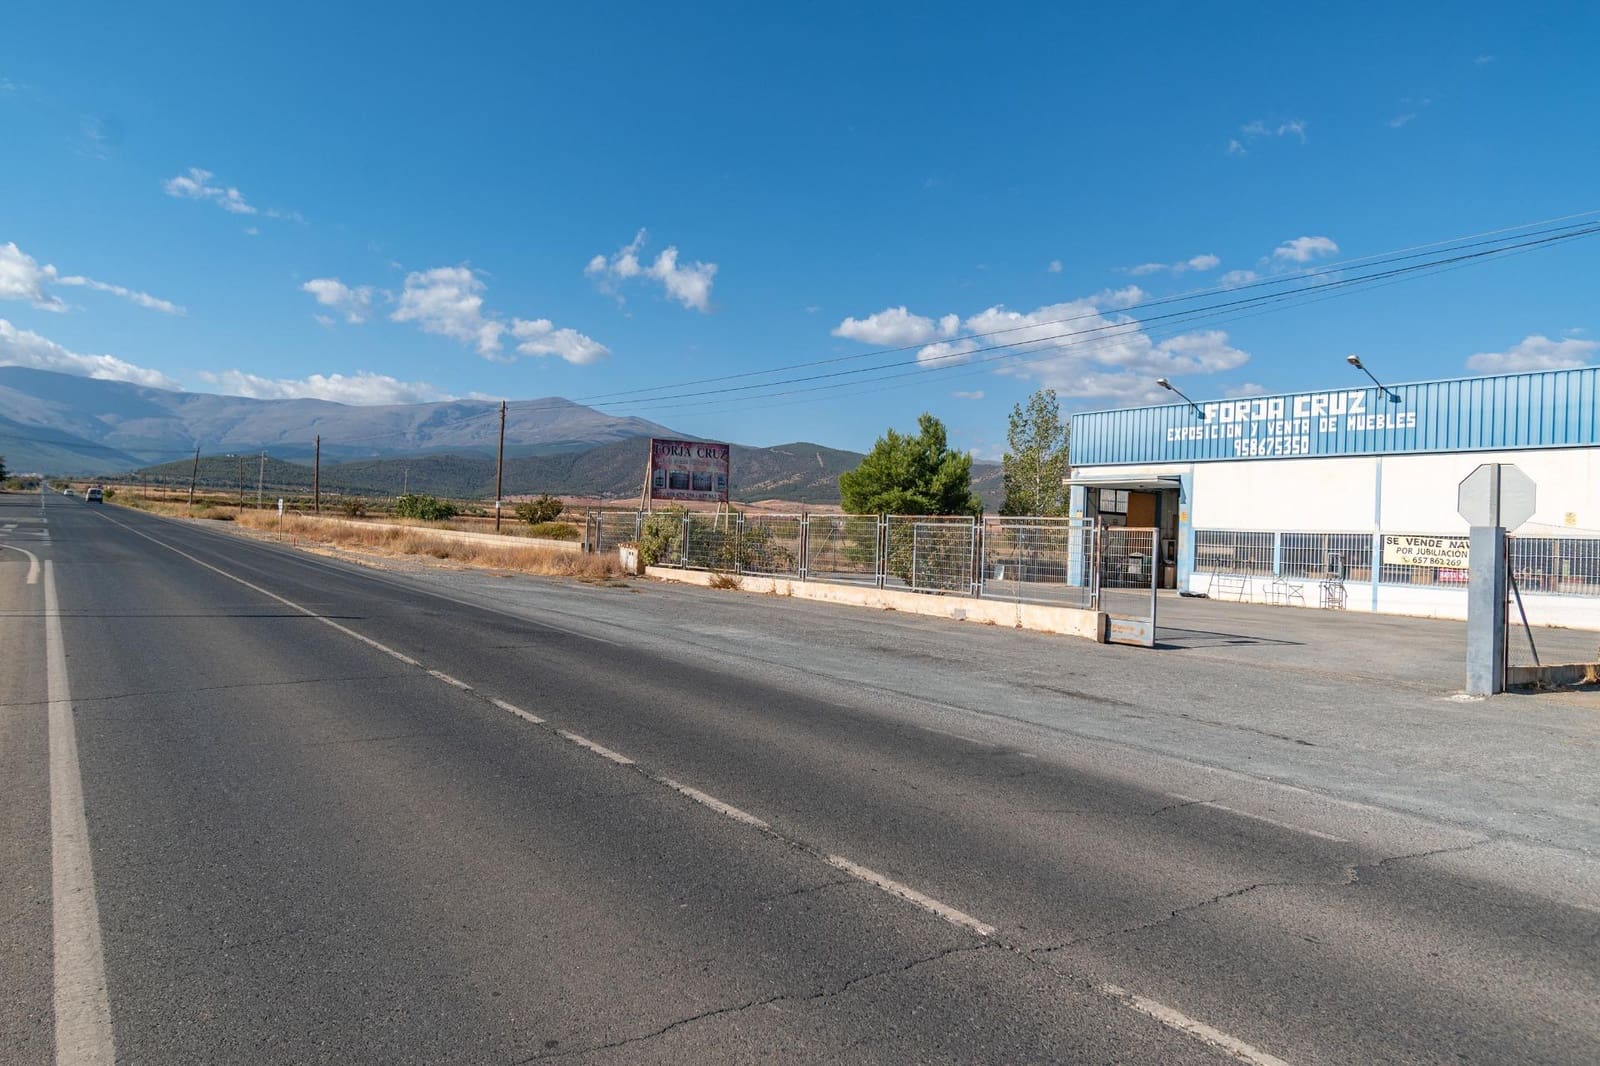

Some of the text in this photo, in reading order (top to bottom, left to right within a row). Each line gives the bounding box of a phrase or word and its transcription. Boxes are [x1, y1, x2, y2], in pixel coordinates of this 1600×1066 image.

[1204, 392, 1366, 423] FORJA CRUZ
[1167, 423, 1242, 441] EXPOSICION
[1267, 420, 1309, 435] VENTA
[1319, 417, 1337, 432] DE
[1347, 412, 1416, 431] MUEBLES
[655, 445, 728, 459] FORJA CRUZ
[1234, 437, 1309, 455] 958675350
[1386, 537, 1399, 545] SE
[1406, 538, 1443, 548] VENDE
